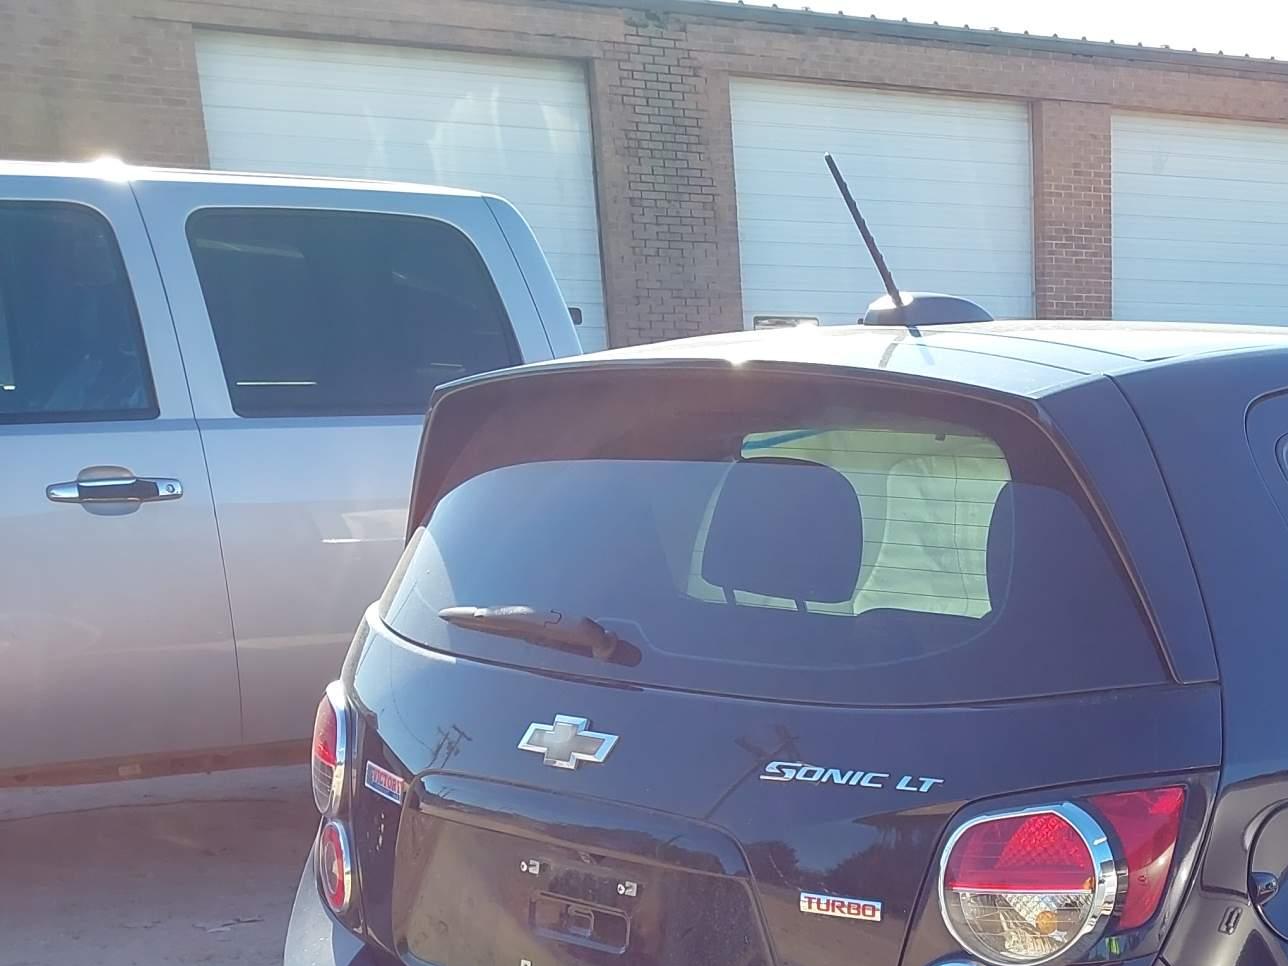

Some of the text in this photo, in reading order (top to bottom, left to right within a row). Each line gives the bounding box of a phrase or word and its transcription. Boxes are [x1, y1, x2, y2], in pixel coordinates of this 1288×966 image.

[759, 761, 945, 793] SONIC LT
[803, 896, 876, 918] TURBO
